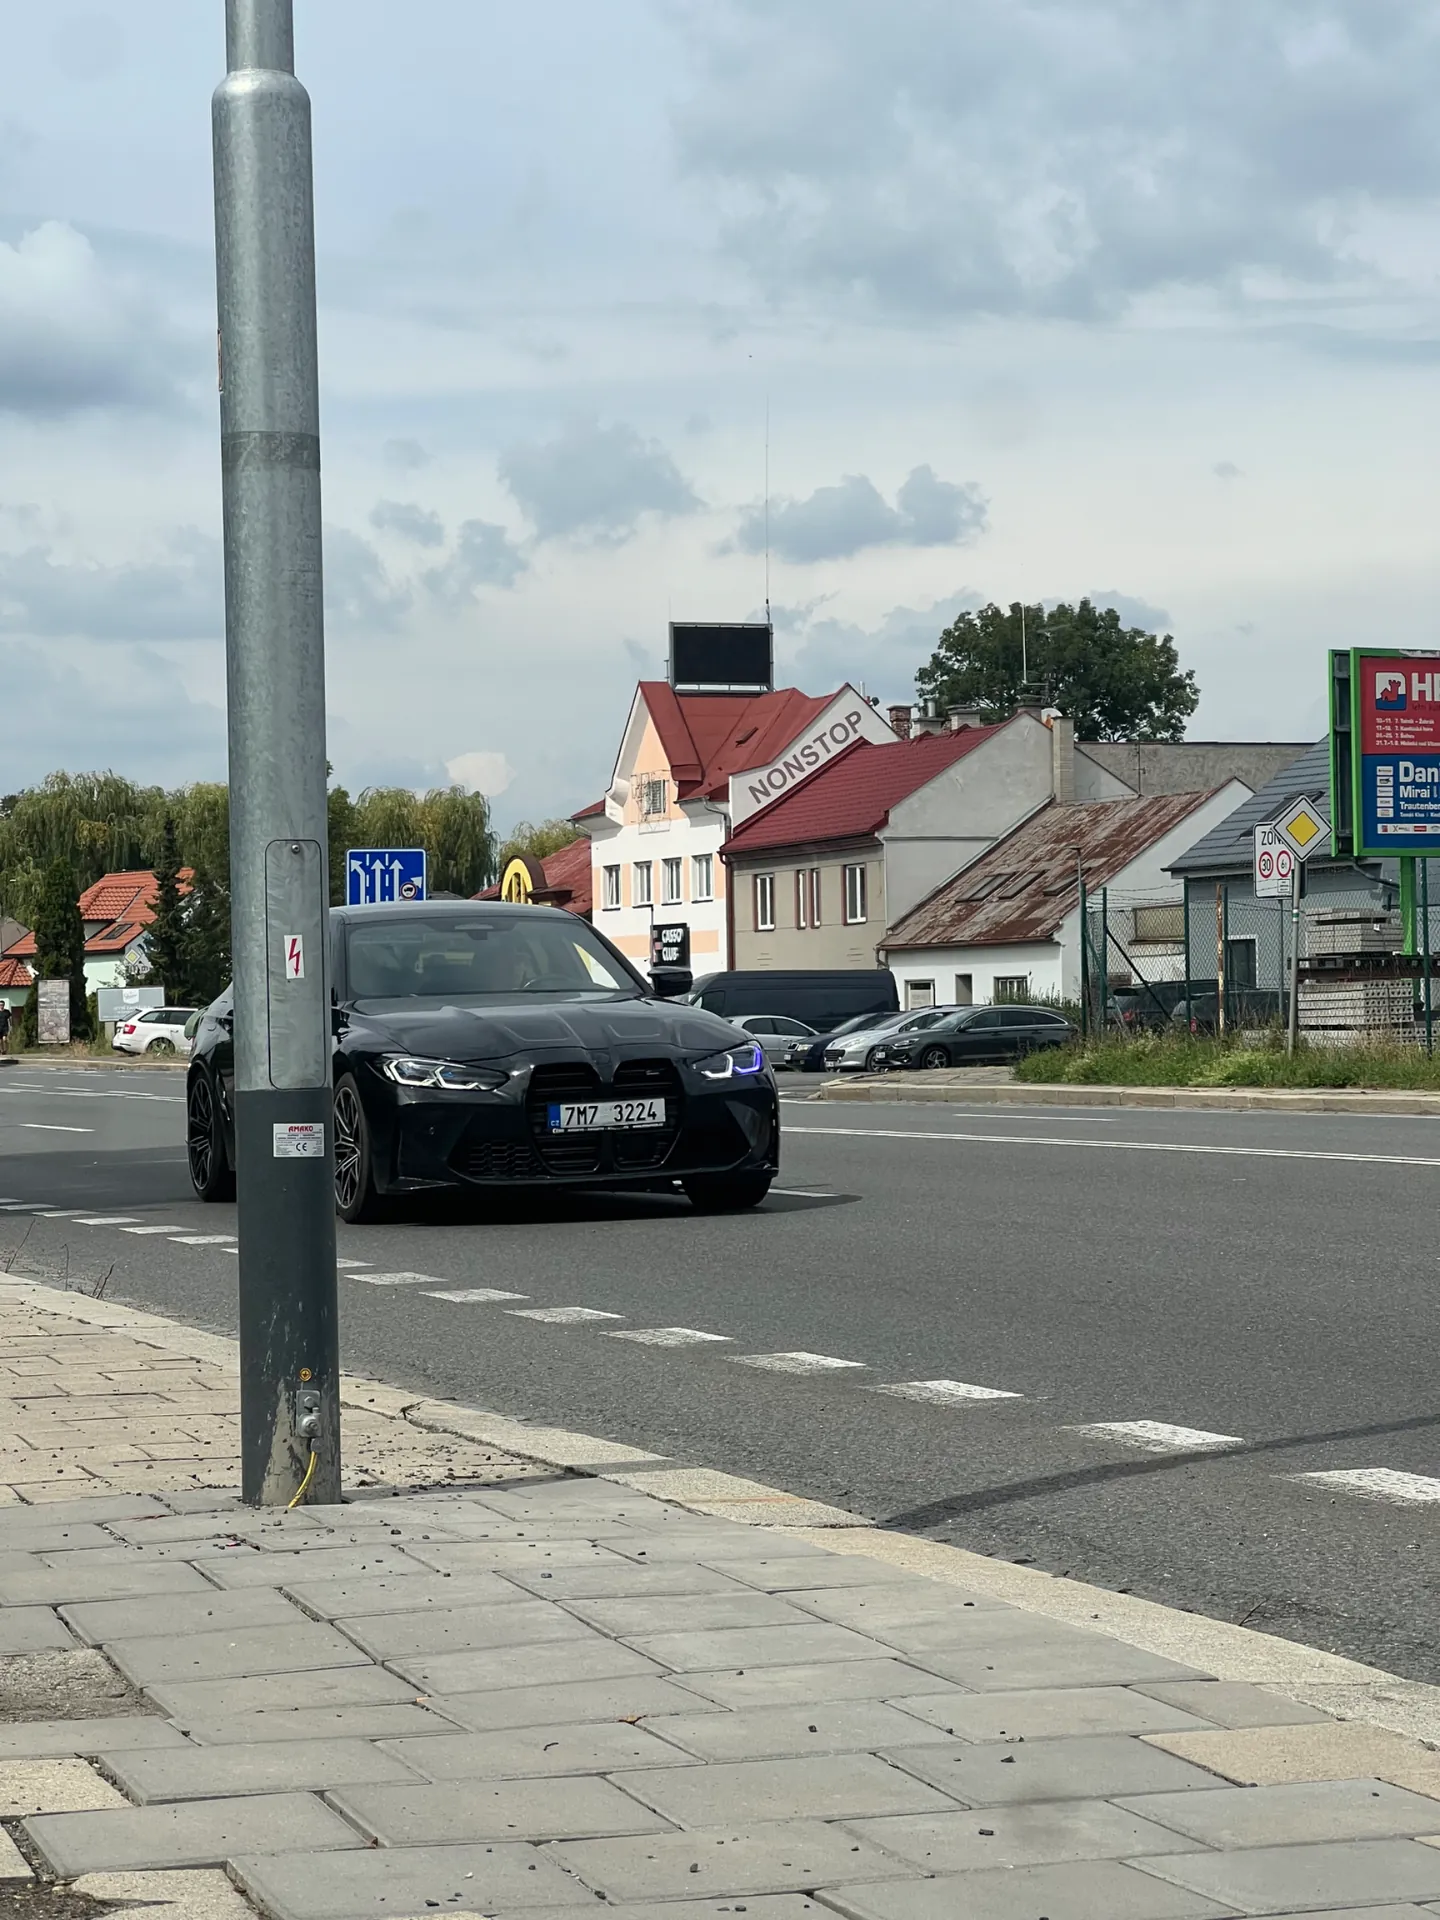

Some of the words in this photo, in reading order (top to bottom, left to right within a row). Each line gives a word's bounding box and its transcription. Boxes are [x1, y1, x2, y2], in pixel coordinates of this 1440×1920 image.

[748, 710, 862, 804] NONSTOP
[1399, 761, 1440, 783] Dan
[1400, 785, 1430, 798] Mirai
[1262, 858, 1271, 872] 30
[565, 1105, 598, 1127] 7M7
[613, 1101, 657, 1122] 3224
[288, 1125, 313, 1133] AMAKO
[550, 1118, 560, 1127] CZ
